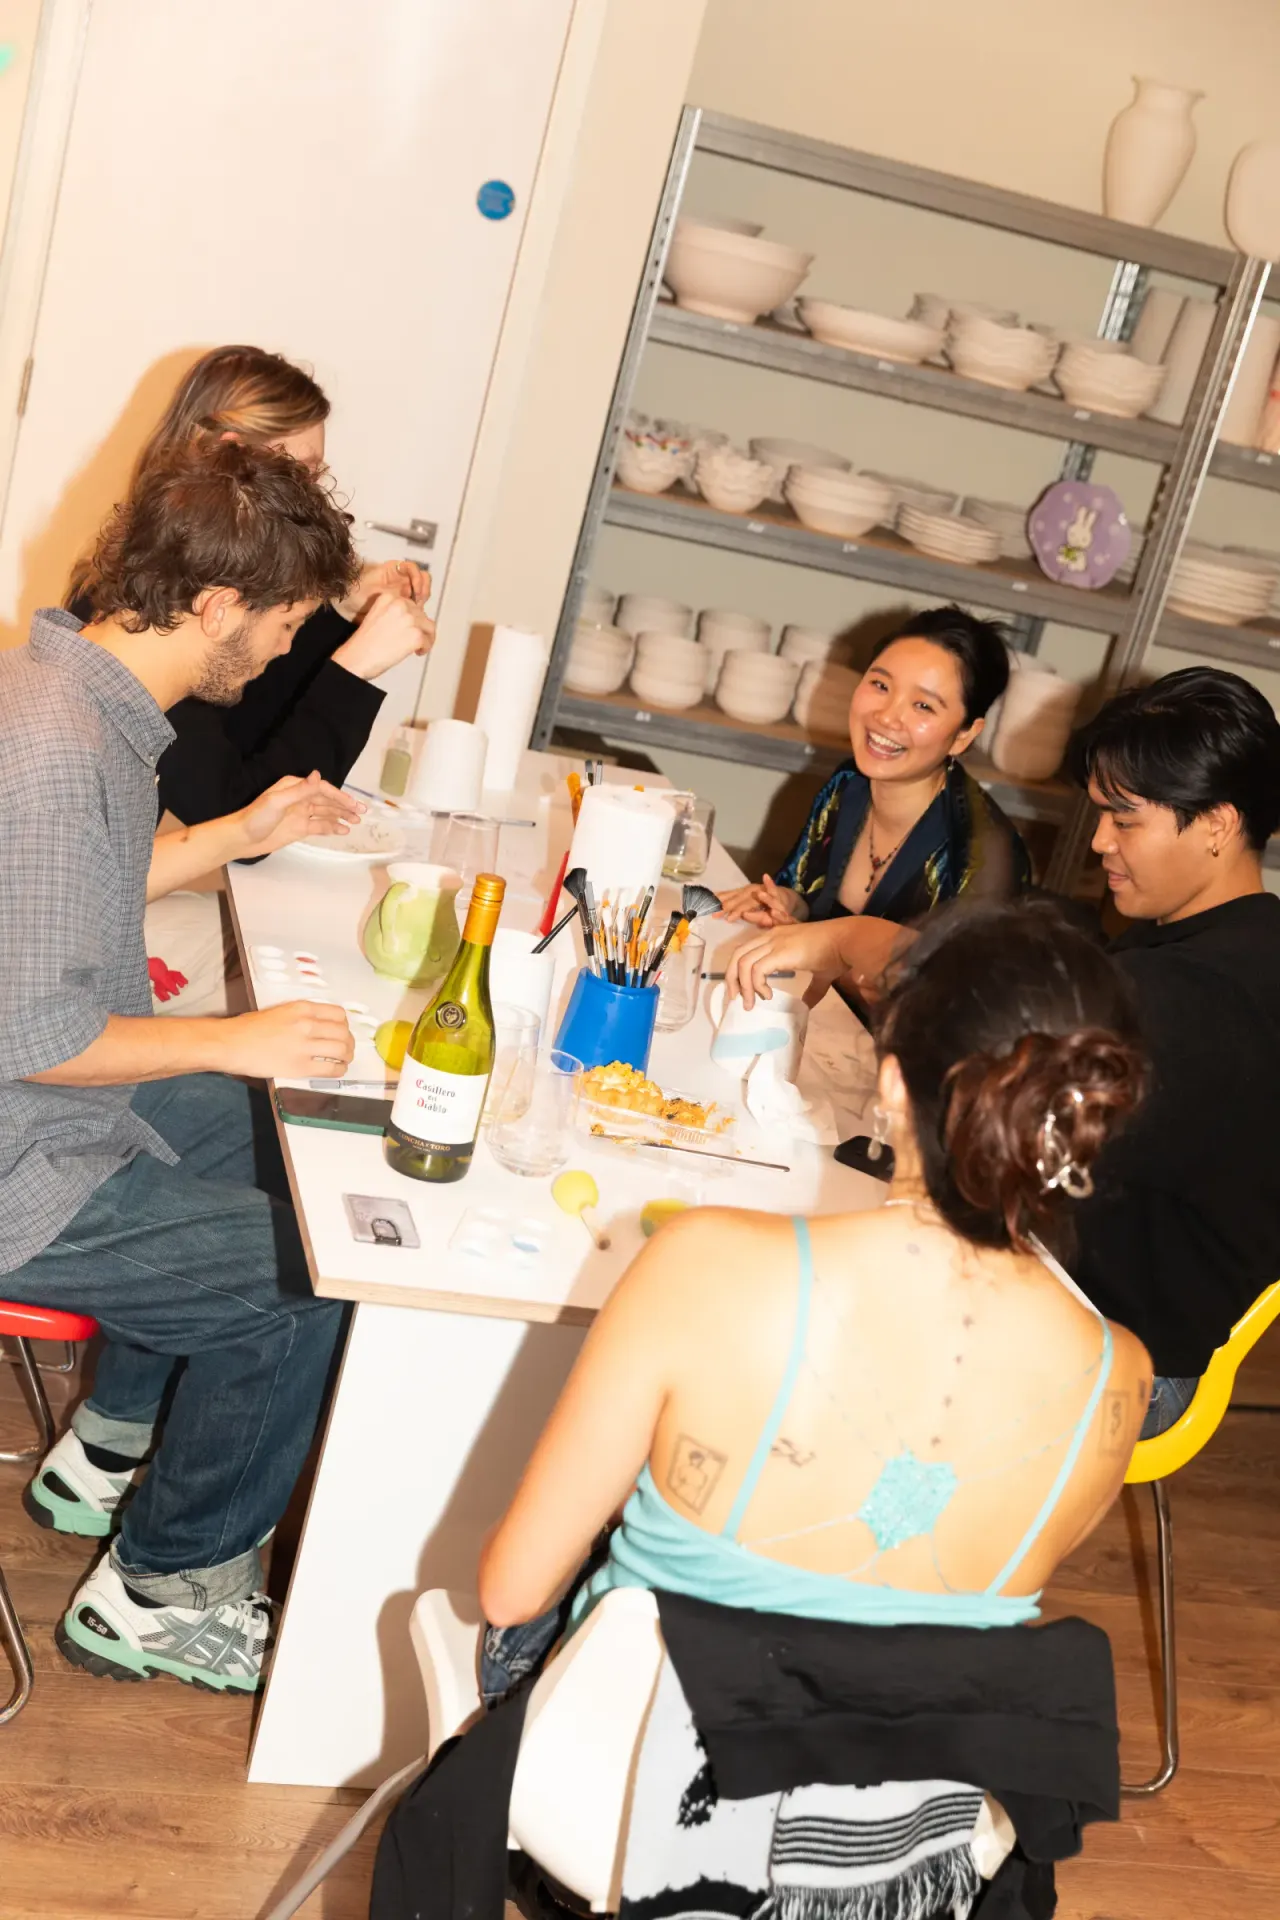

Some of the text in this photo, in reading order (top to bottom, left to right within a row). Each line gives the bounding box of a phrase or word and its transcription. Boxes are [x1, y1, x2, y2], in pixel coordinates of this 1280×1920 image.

[415, 1079, 456, 1098] Casillero
[416, 1097, 447, 1114] Diablo
[430, 1143, 451, 1152] TORO
